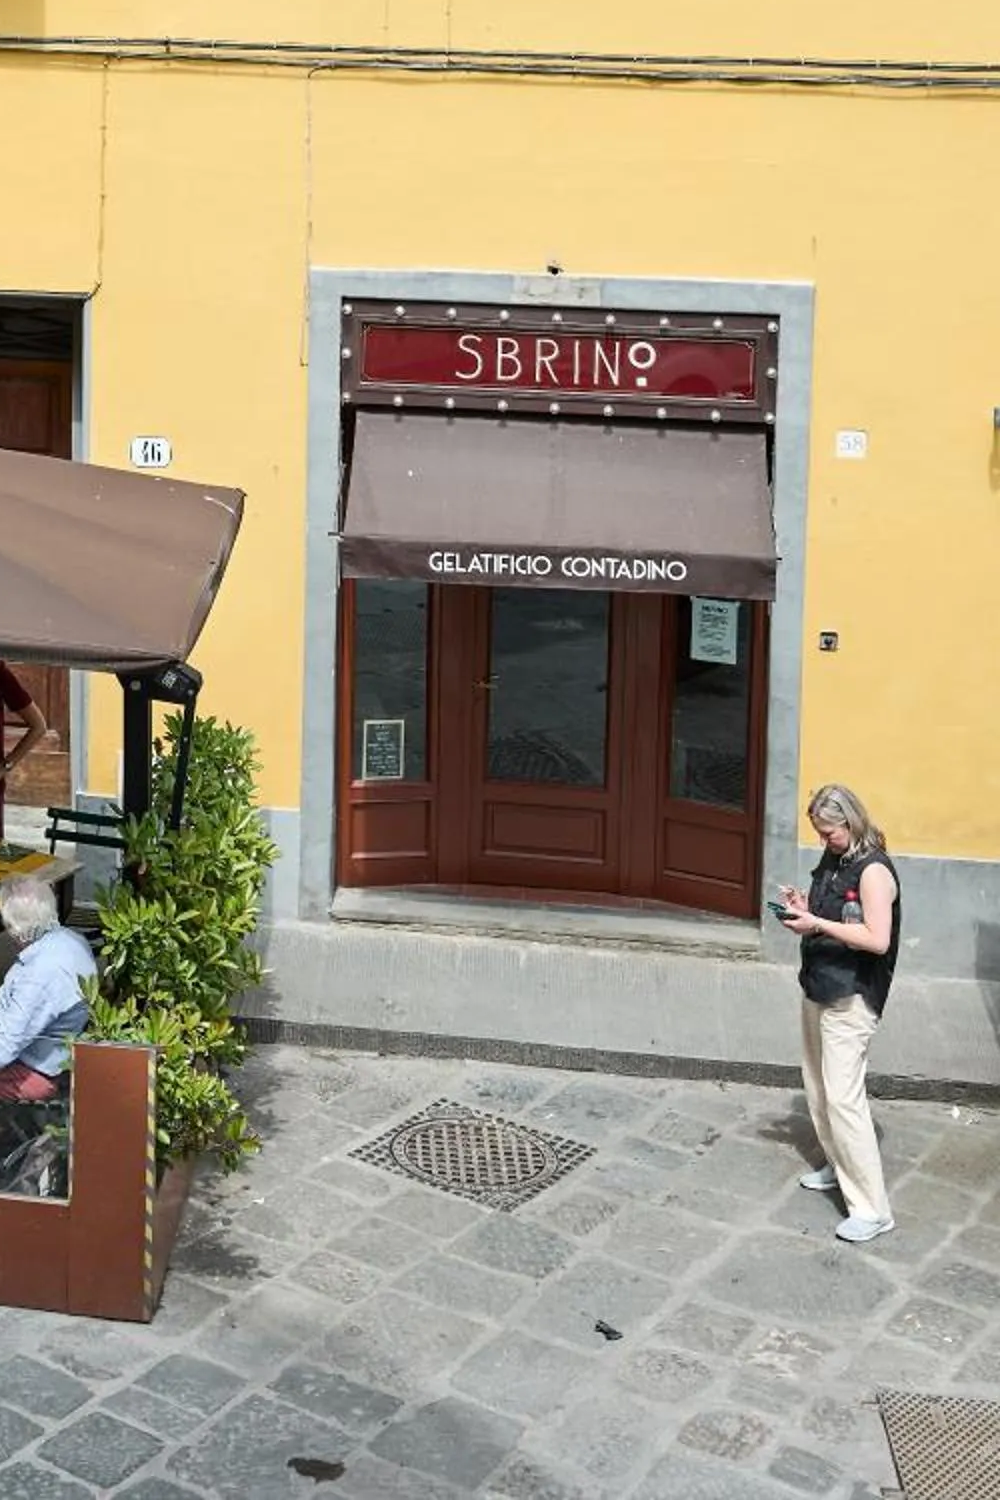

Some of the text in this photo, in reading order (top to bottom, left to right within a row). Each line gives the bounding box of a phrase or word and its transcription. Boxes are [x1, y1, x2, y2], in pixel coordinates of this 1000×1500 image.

[455, 334, 657, 387] SBRINO
[428, 551, 688, 581] GELATIFICIO CONTADINO
